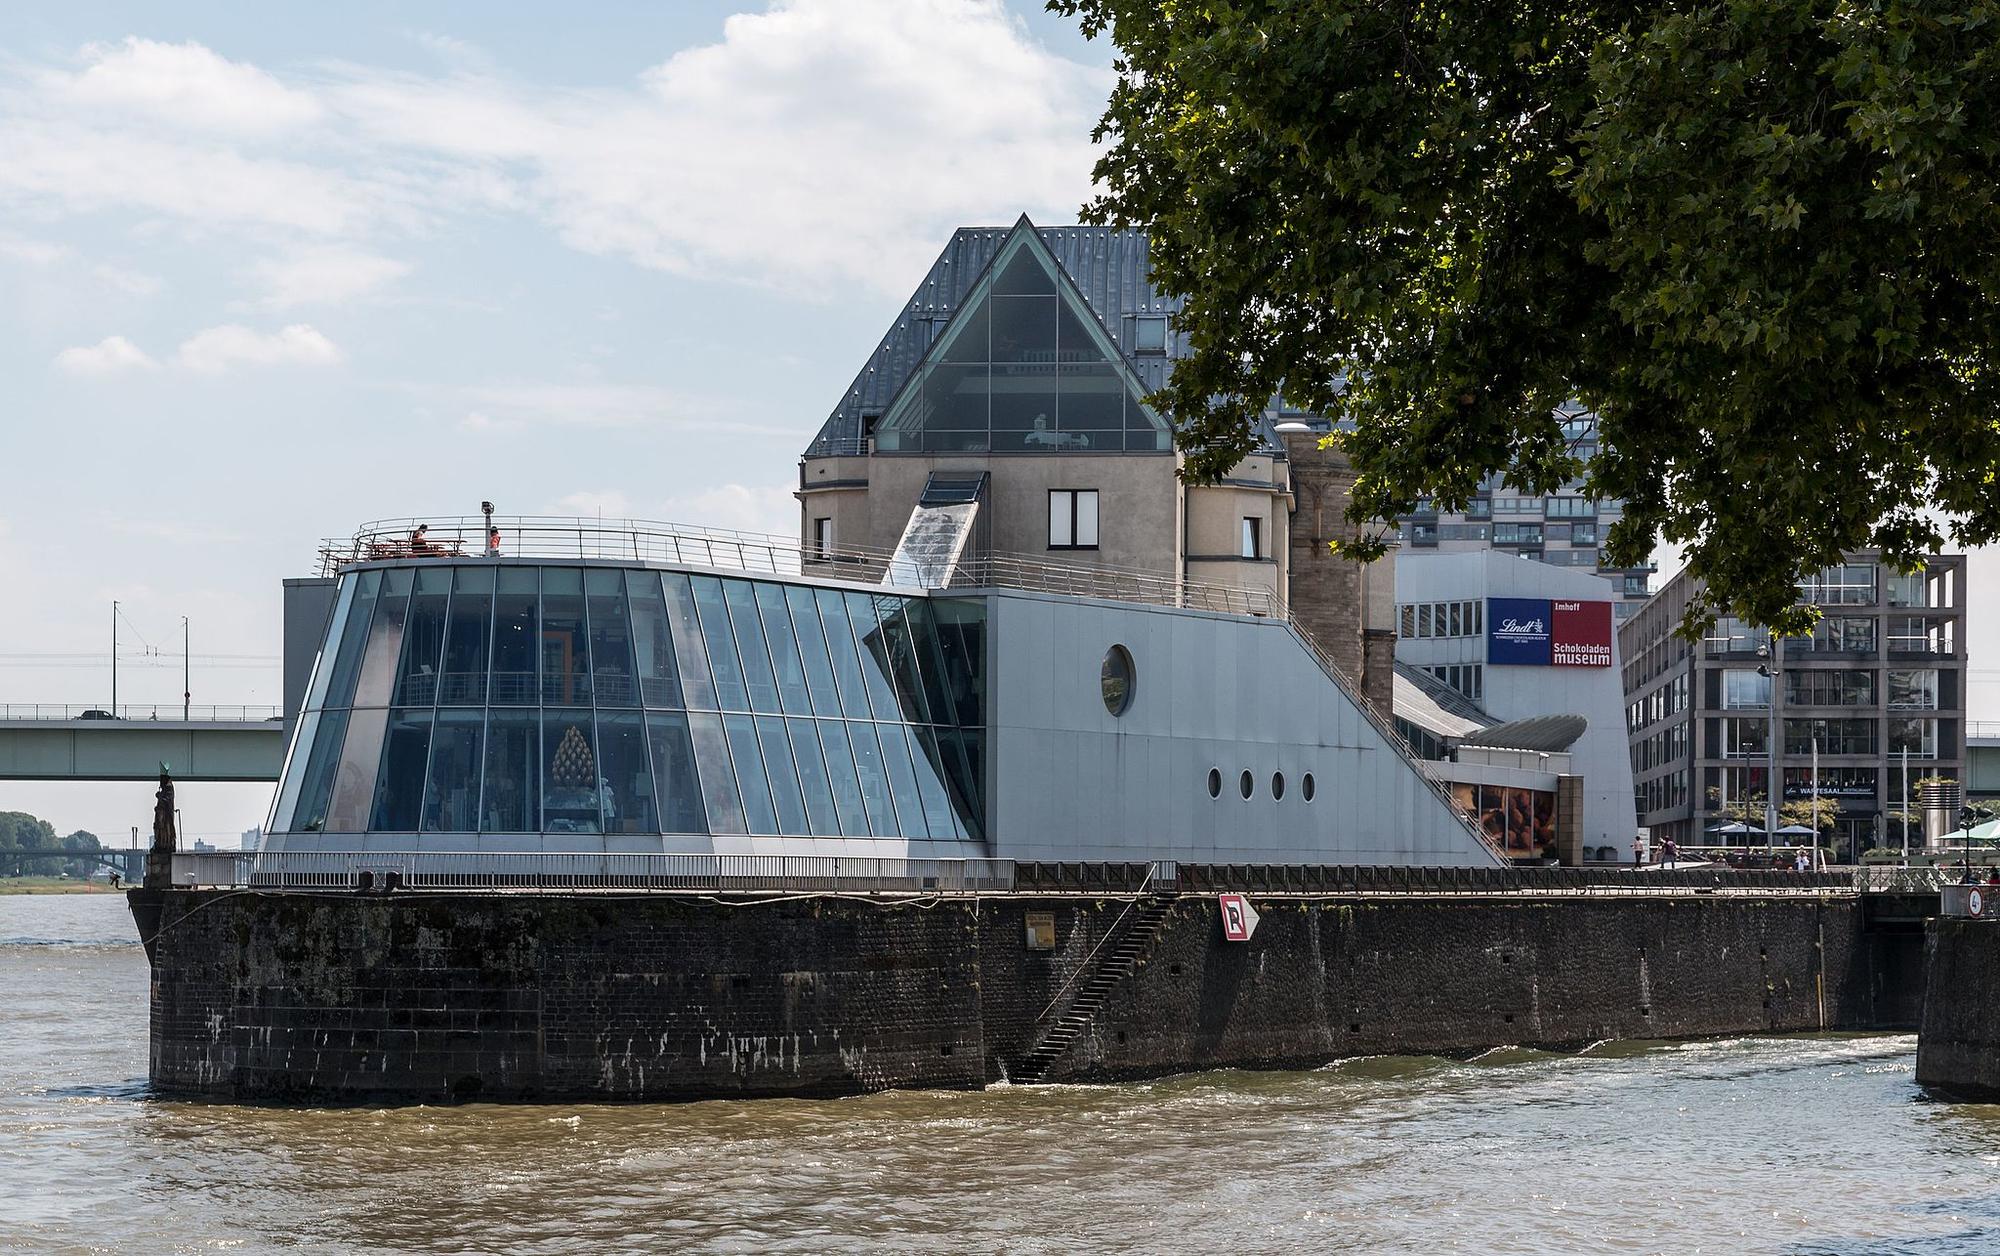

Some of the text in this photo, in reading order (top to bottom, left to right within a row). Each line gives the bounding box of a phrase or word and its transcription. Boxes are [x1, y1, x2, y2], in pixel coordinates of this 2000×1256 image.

[1555, 602, 1580, 611] Imhoff
[1498, 619, 1535, 632] Lindt
[1554, 643, 1610, 654] Schokoladen
[1554, 653, 1610, 665] museum
